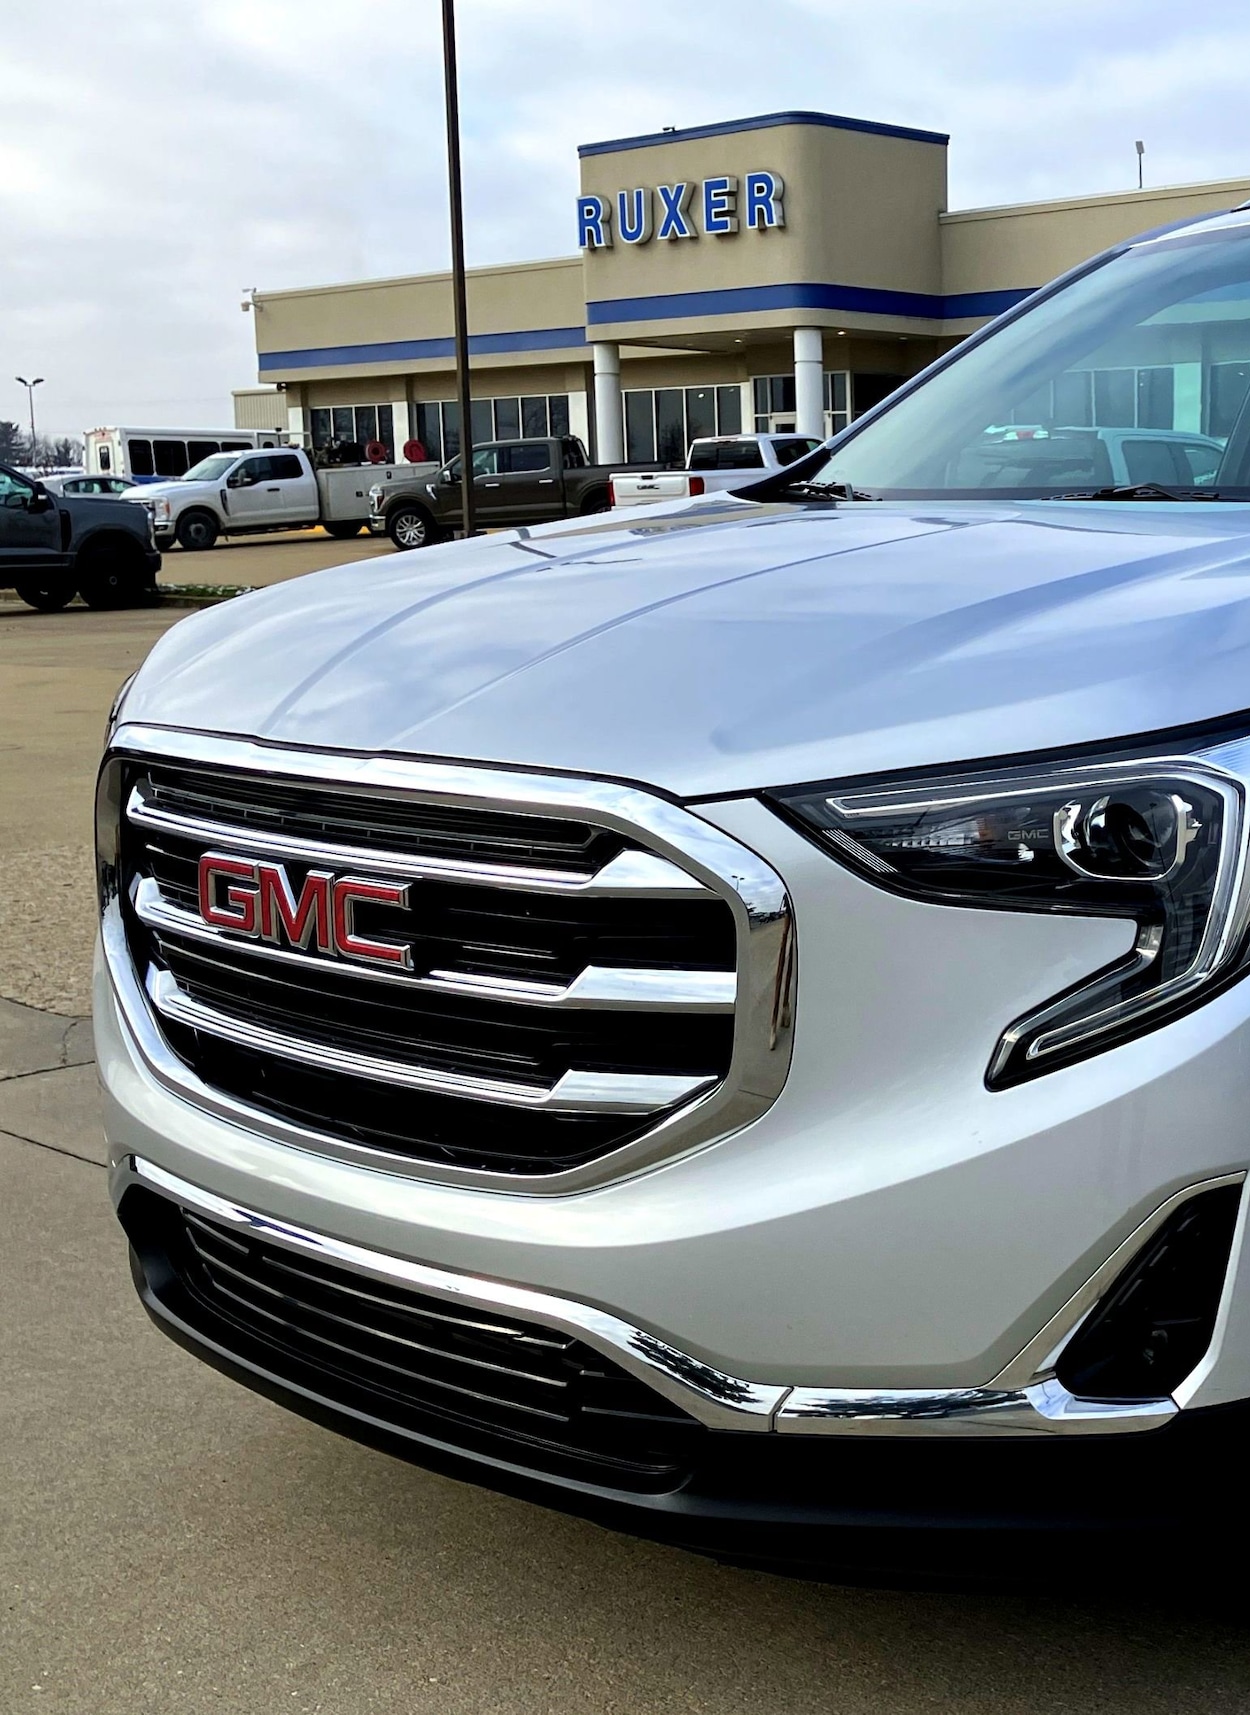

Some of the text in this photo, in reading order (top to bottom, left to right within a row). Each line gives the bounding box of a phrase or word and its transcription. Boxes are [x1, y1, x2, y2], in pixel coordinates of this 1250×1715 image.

[576, 171, 785, 249] RUXER
[1008, 828, 1049, 840] GMC
[199, 851, 414, 971] GMC
